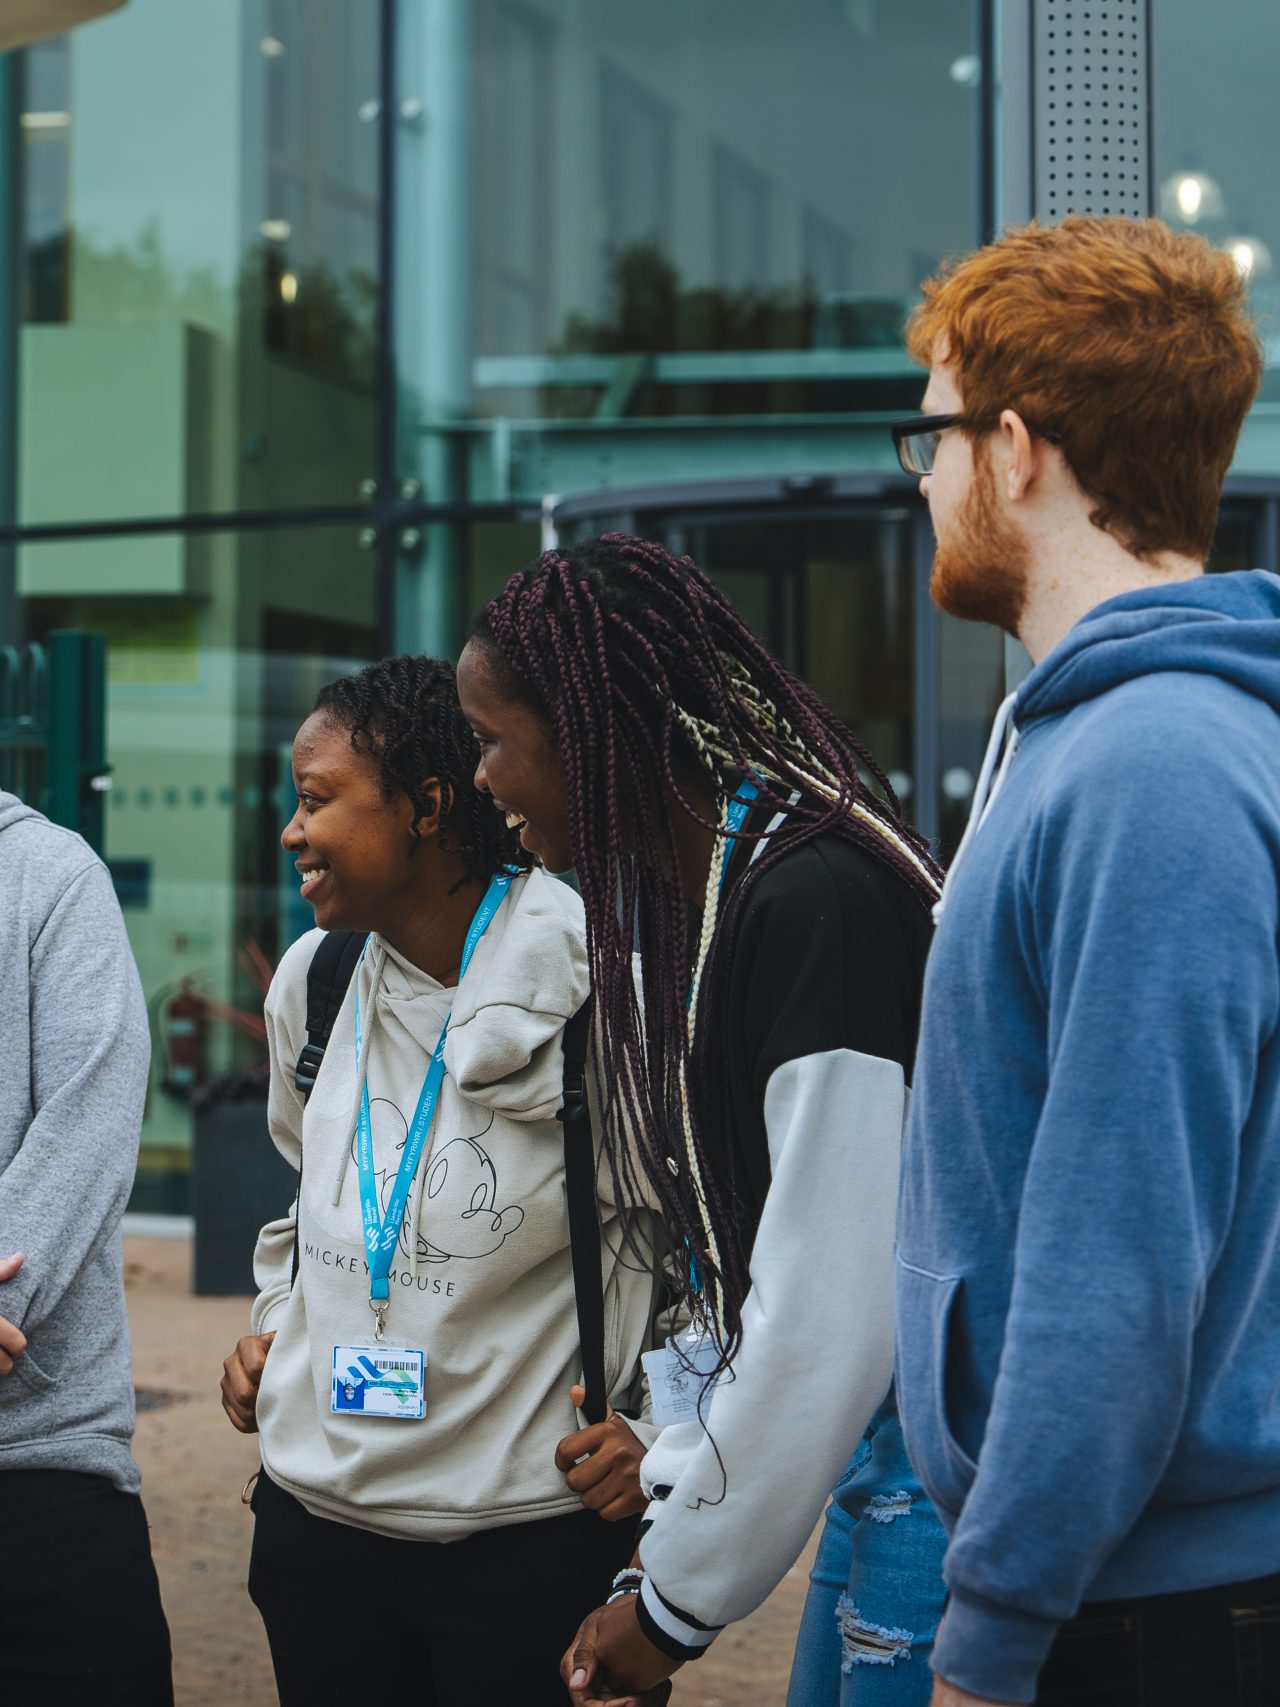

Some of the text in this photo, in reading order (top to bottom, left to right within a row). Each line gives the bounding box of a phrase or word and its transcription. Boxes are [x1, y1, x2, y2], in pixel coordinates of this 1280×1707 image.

[471, 906, 492, 939] STUDENT
[361, 1132, 369, 1171] MYFYRIWR
[404, 1131, 422, 1172] MYFYRIWR
[418, 1091, 433, 1126] STUDENT
[305, 1242, 456, 1297] MICKEY MOUSE
